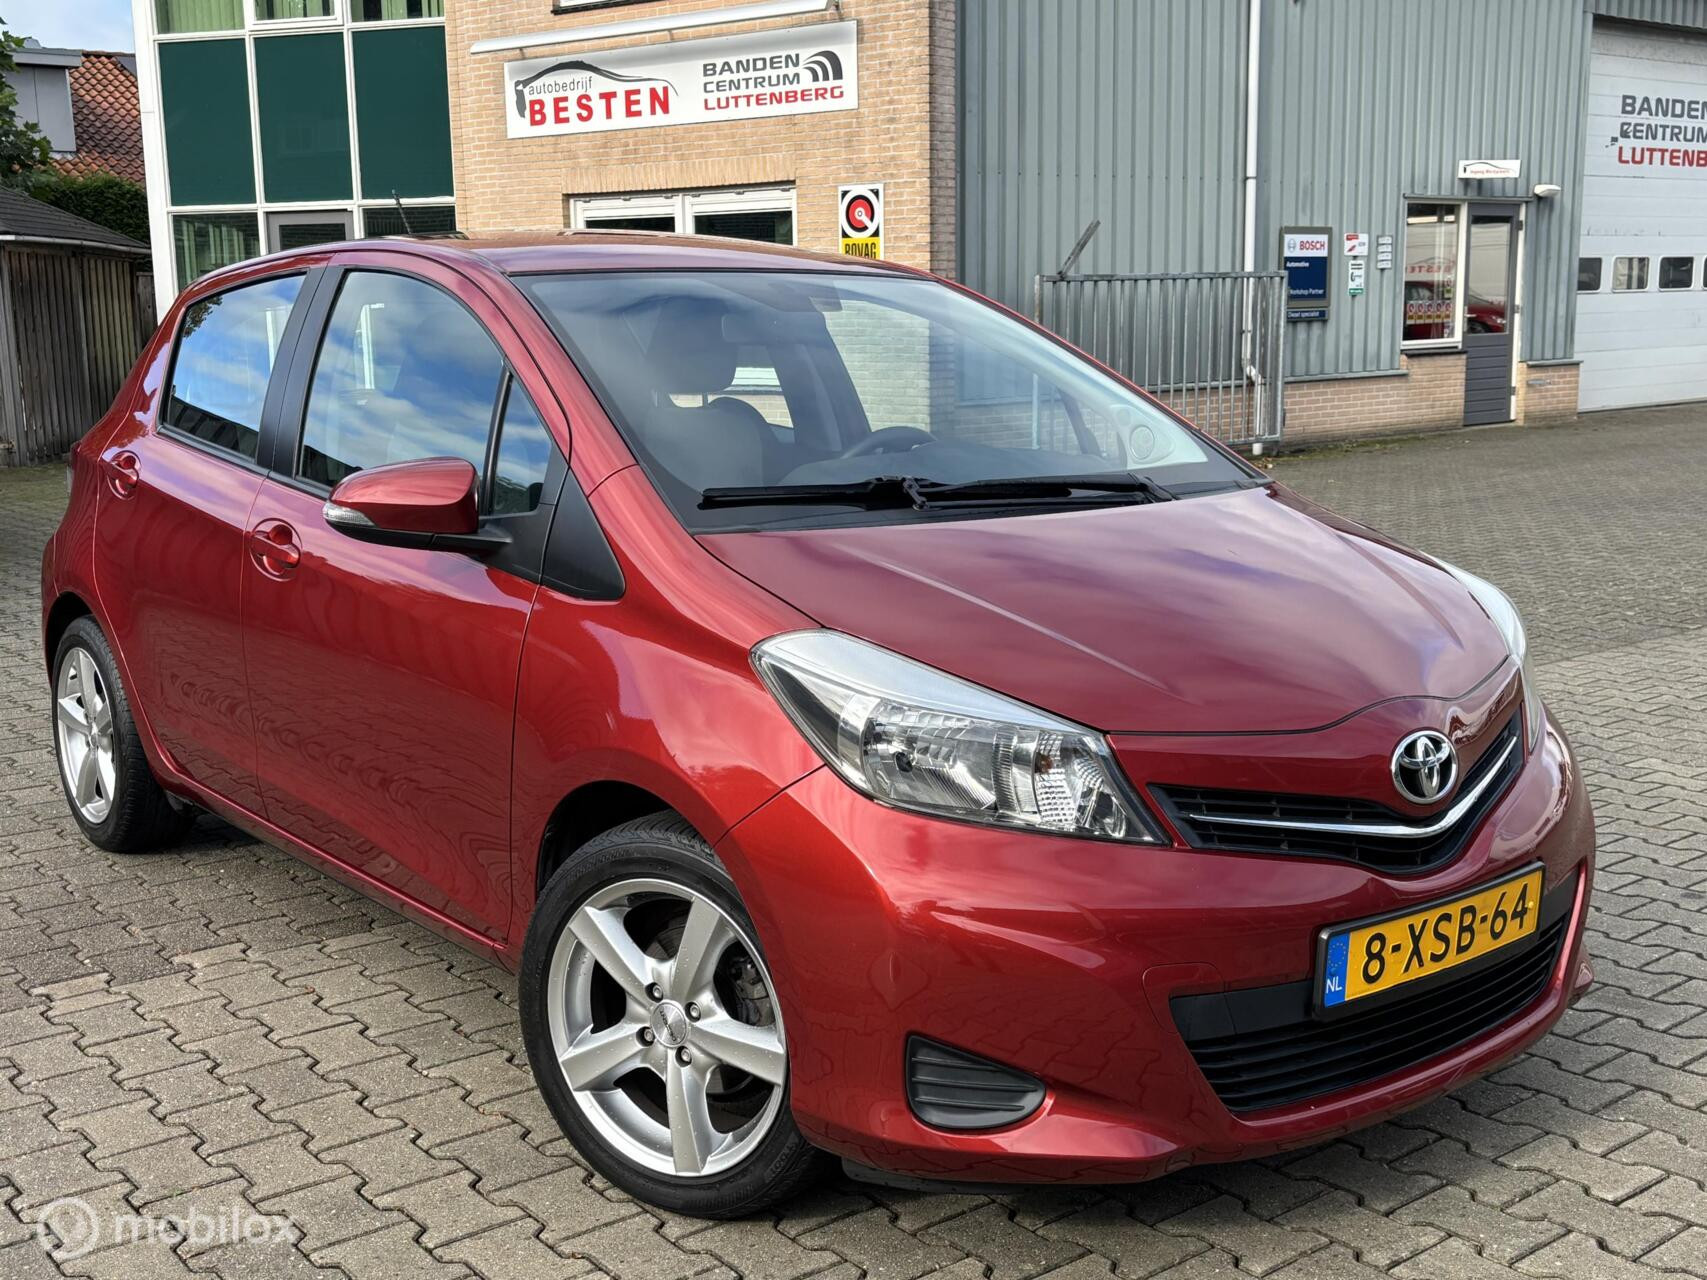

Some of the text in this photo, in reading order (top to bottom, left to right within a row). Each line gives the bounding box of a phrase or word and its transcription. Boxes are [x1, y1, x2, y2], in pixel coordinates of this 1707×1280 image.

[703, 53, 800, 77] BANDEN
[528, 77, 593, 96] autobedrijf
[703, 72, 801, 94] CENTRUM
[529, 86, 670, 126] BESTEN
[704, 85, 845, 111] LUTTENBERG
[1618, 146, 1707, 167] LUTTENB
[845, 242, 877, 259] BOVAG
[1299, 240, 1325, 251] BOSCH
[1361, 882, 1529, 985] 8-XSB-64
[1326, 976, 1343, 994] NL
